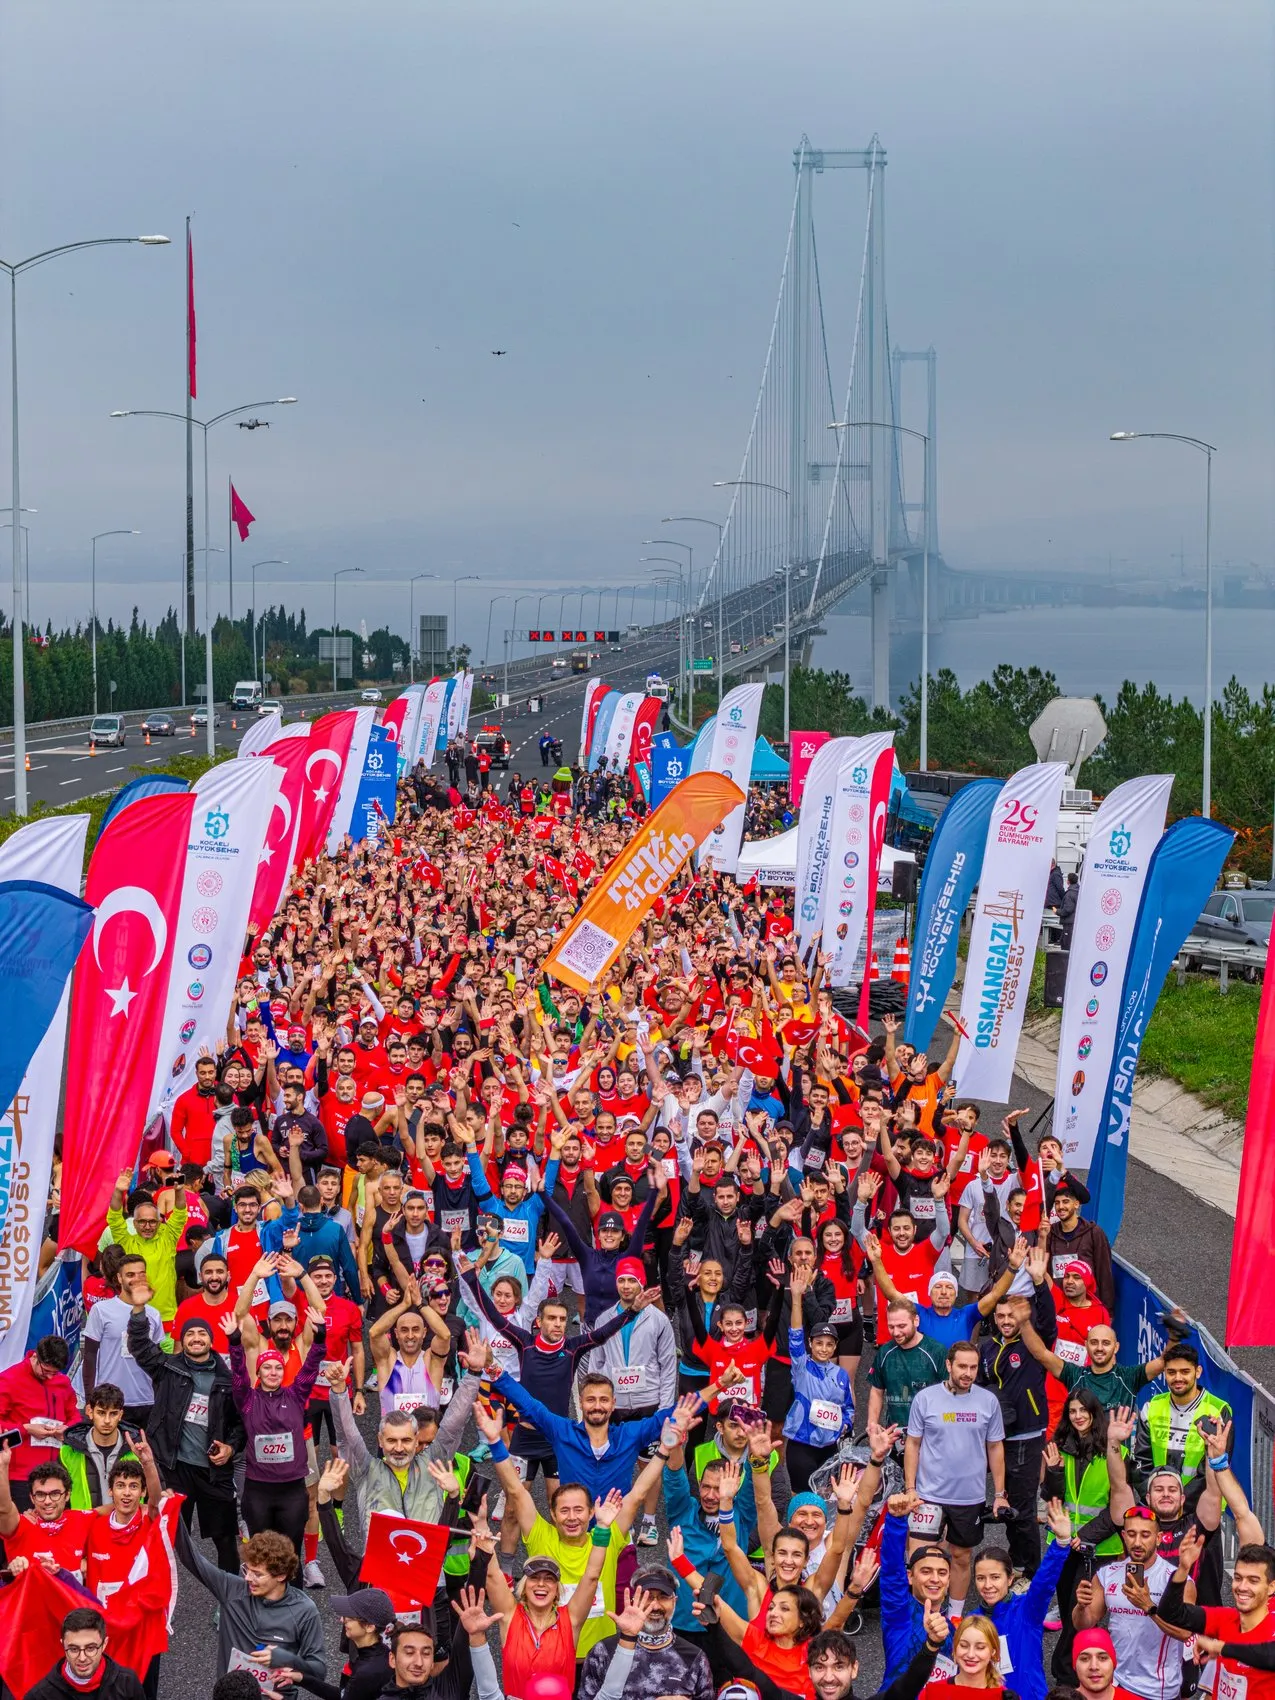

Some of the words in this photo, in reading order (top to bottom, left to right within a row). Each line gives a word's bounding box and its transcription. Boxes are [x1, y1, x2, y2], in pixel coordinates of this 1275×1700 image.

[1001, 799, 1036, 833] 29
[643, 832, 696, 895] club
[606, 843, 660, 905] run
[1006, 945, 1025, 1010] KOŞUSU
[974, 922, 1012, 1049] OSMANGAZİ
[990, 944, 1017, 1048] CUMHURİYET
[914, 1205, 934, 1213] 6243
[13, 1161, 31, 1282] KOŞUSU
[445, 1216, 465, 1225] 4897
[506, 1227, 526, 1236] 4249
[490, 1339, 513, 1349] 6652
[1059, 1349, 1081, 1362] 6758
[617, 1375, 640, 1385] 6657
[816, 1409, 839, 1422] 5016
[263, 1443, 287, 1454] 6276
